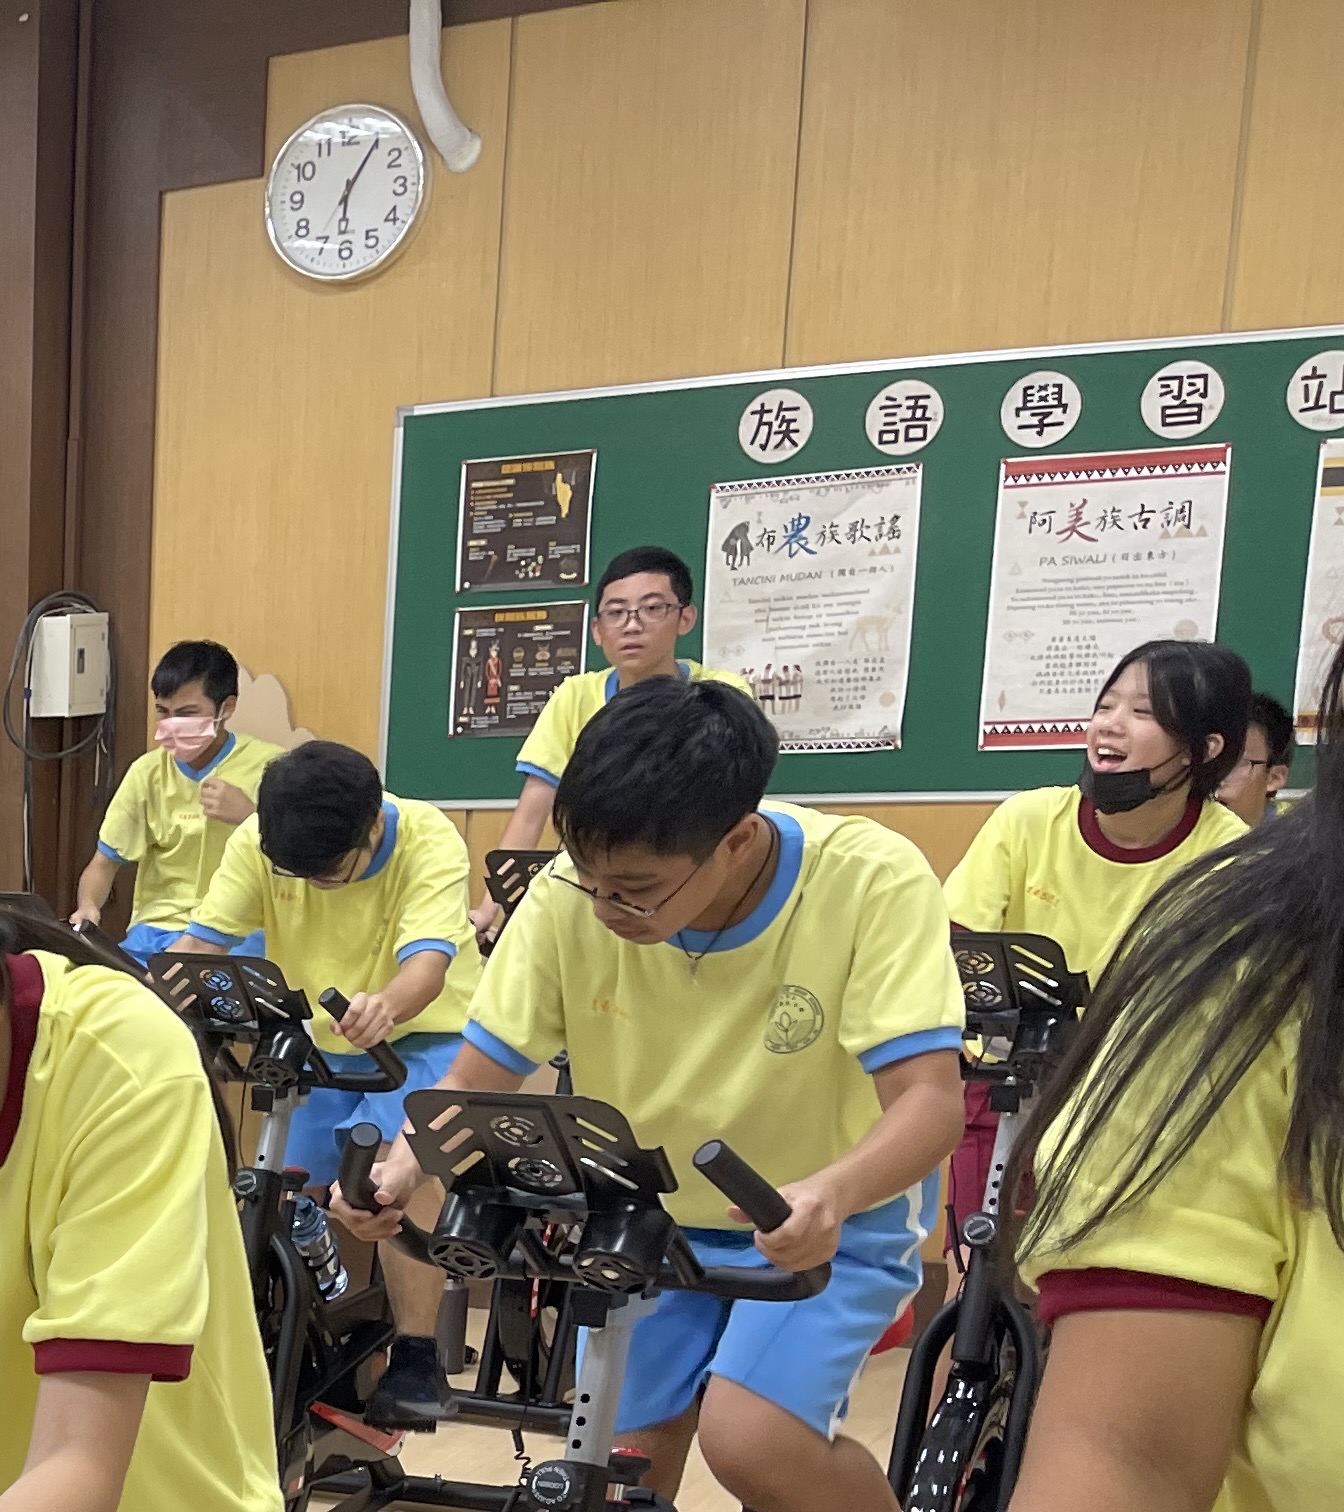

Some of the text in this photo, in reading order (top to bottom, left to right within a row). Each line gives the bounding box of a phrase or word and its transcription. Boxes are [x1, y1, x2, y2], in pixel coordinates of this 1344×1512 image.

[316, 137, 332, 158] 11
[386, 147, 403, 169] 2
[295, 160, 317, 182] 10
[392, 175, 408, 197] 3
[289, 190, 305, 212] 9
[383, 204, 400, 226] 4
[294, 217, 310, 239] 8
[364, 228, 380, 249] 5
[315, 235, 330, 256] 7
[337, 239, 353, 261] 6
[1027, 497, 1194, 544] 阿美族古調
[1038, 556, 1058, 568] PA
[1061, 552, 1108, 567] SIWALI
[779, 570, 823, 584] MUDAN
